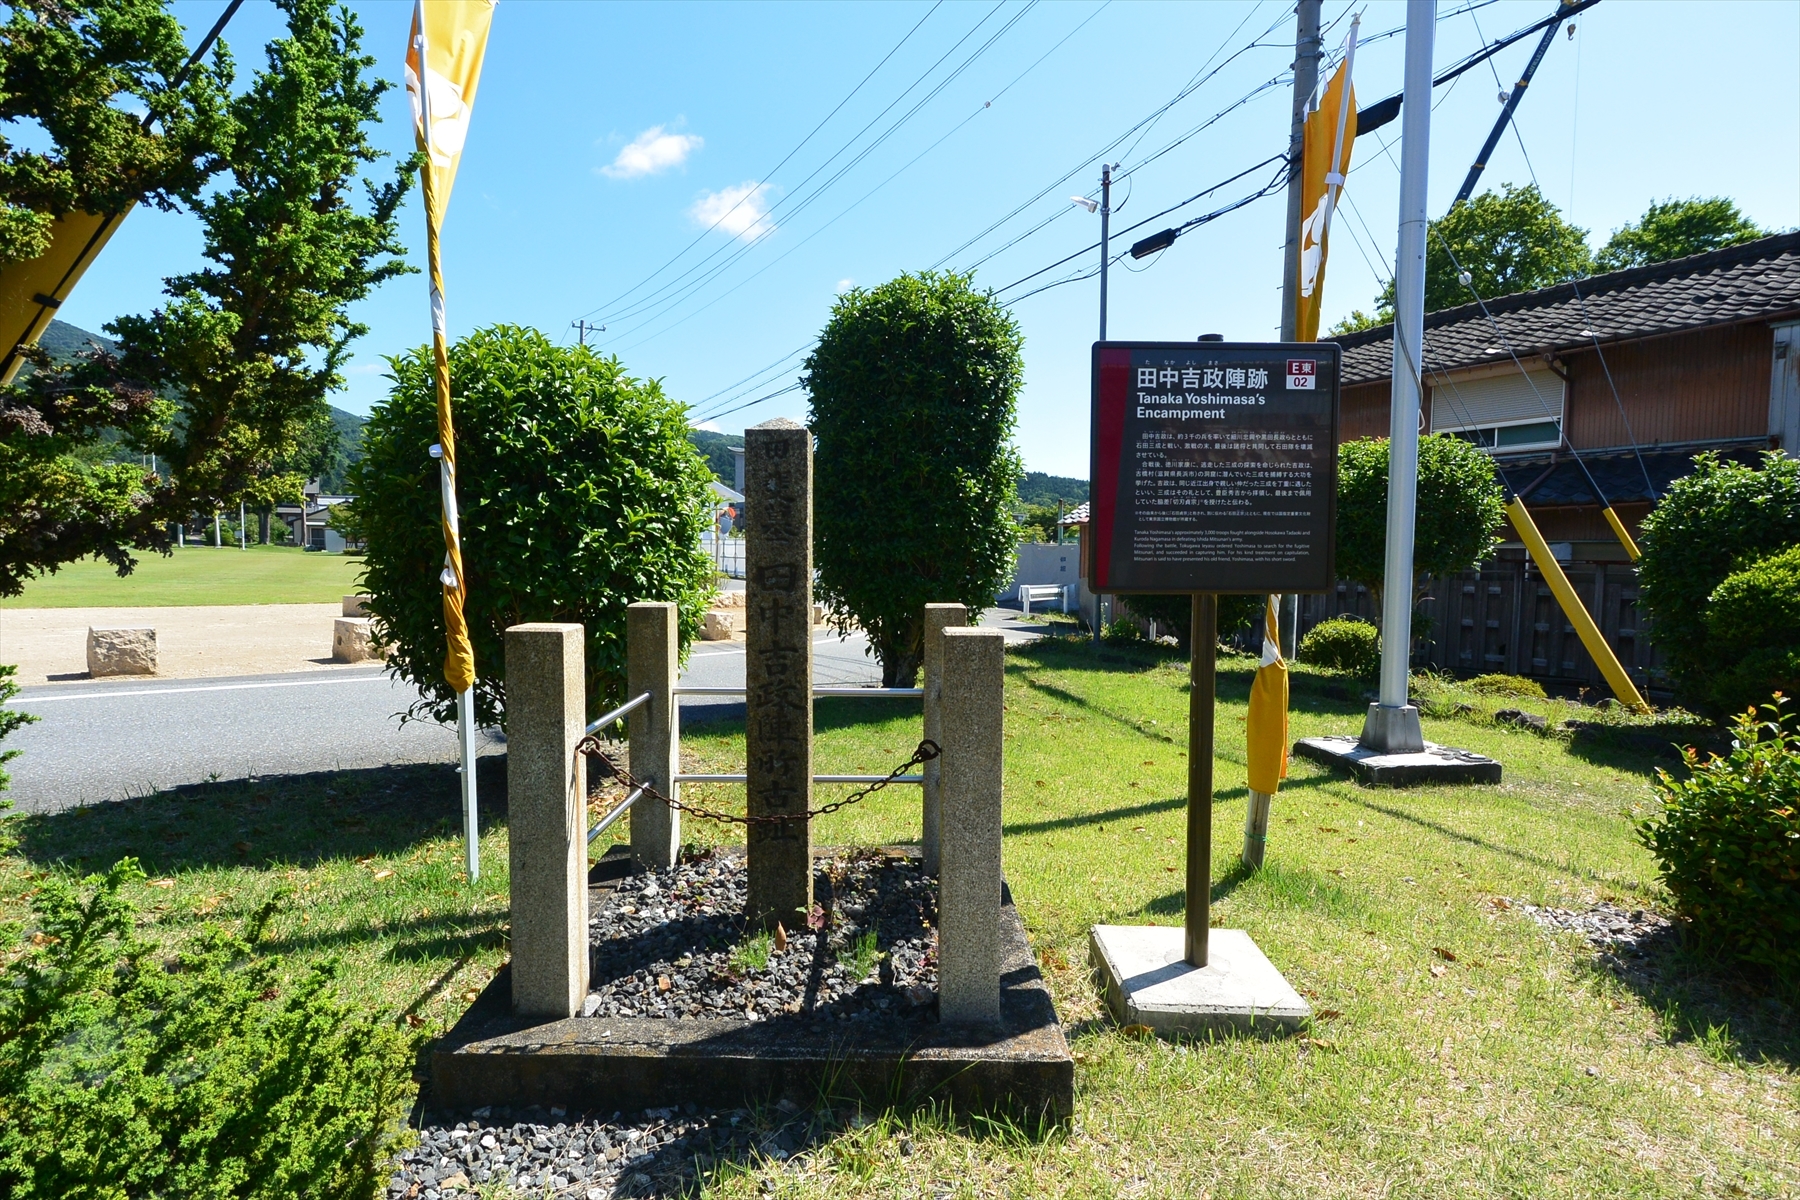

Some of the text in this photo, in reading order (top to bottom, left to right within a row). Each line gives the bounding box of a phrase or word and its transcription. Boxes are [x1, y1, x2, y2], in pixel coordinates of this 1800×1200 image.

[1137, 368, 1269, 390] 田中吉政陣跡
[1293, 377, 1308, 387] 02
[1137, 392, 1266, 405] Tanaka Yoshimasa's
[1137, 406, 1226, 421] Encampment
